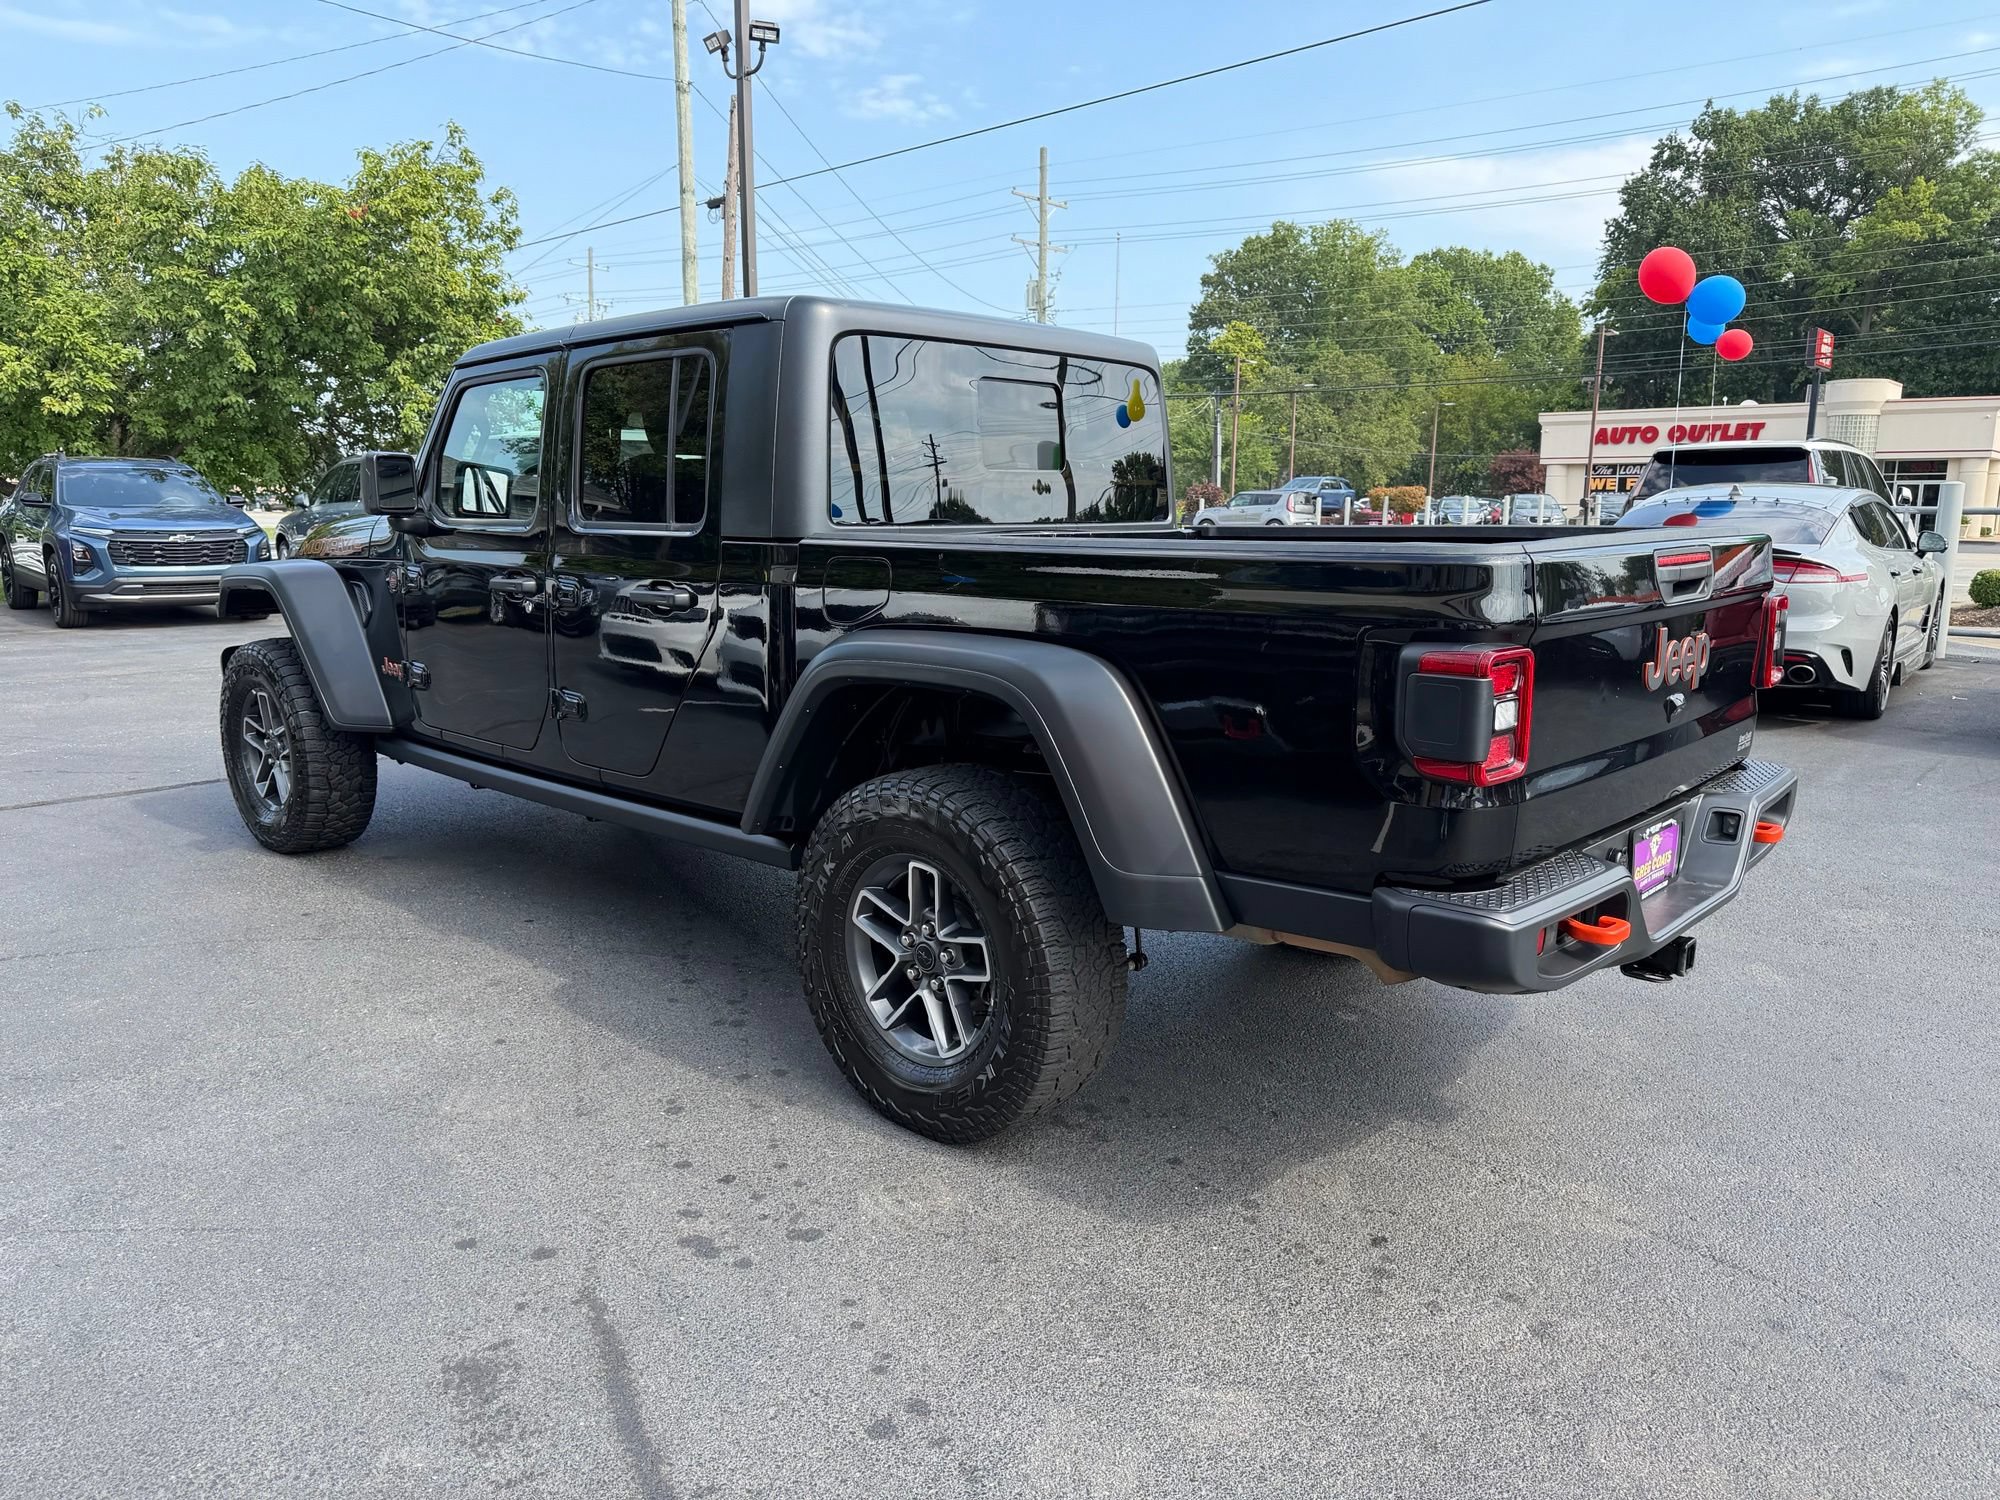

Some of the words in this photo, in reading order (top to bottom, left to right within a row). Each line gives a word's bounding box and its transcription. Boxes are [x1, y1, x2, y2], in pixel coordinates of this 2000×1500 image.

[1594, 425, 1659, 445] AUTO
[1667, 422, 1766, 443] OUTLET
[1592, 464, 1614, 476] The
[1590, 477, 1617, 490] WE
[1642, 627, 1711, 691] Jeep
[1634, 860, 1652, 881] GREG
[1652, 850, 1673, 872] COATS
